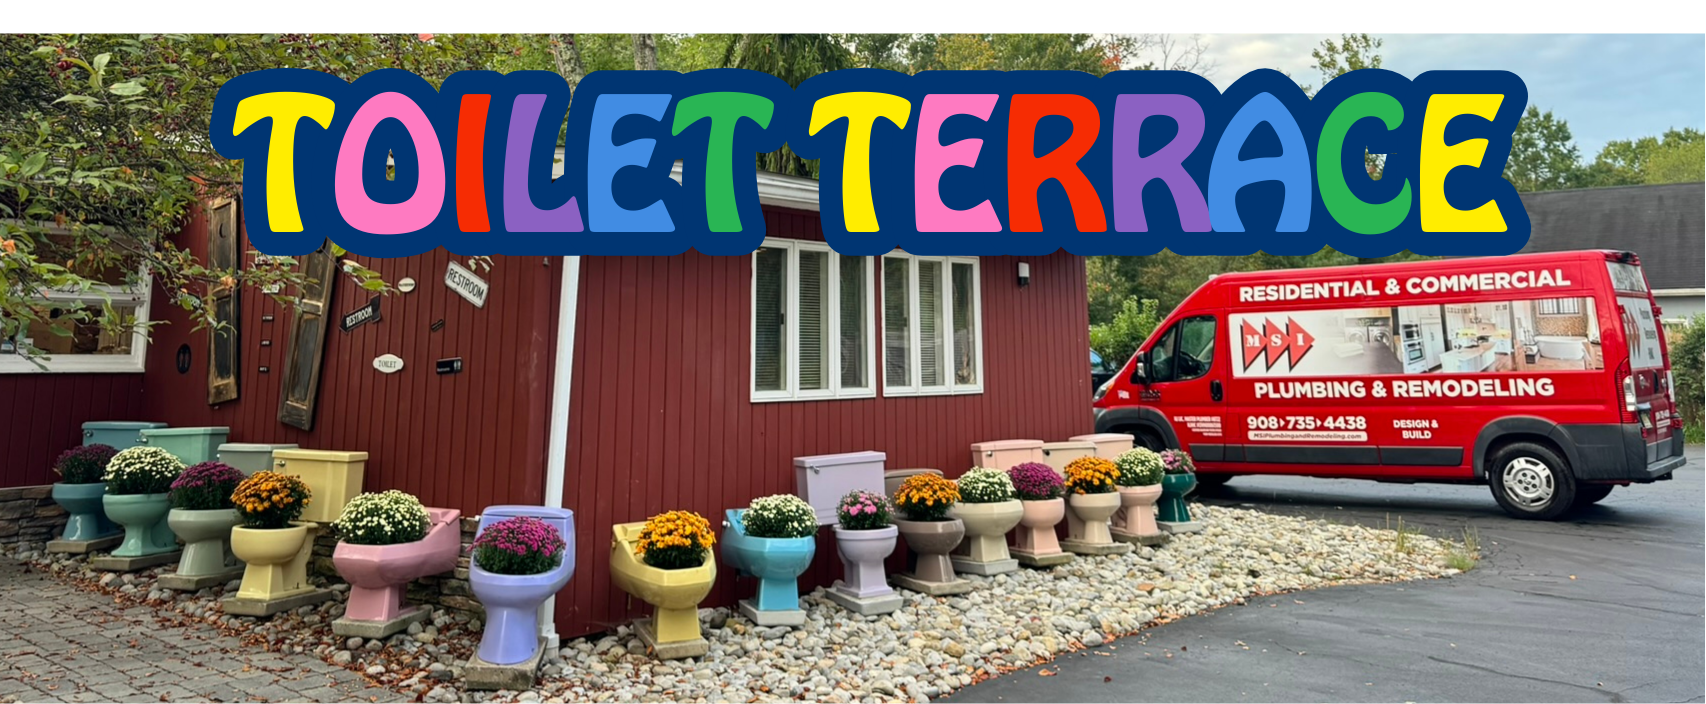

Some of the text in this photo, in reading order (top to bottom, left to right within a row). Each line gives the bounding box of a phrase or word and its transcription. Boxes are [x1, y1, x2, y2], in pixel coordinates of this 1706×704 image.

[447, 268, 484, 301] RESTROOM
[1239, 269, 1571, 302] RESIDENTIAL & COMMERCIAL
[345, 305, 373, 328] RESTROOM
[378, 360, 397, 369] TOILET
[1255, 378, 1555, 399] PLUMBING & REMODELING
[1393, 419, 1439, 429] DESIGN &
[1402, 430, 1432, 439] BUILD
